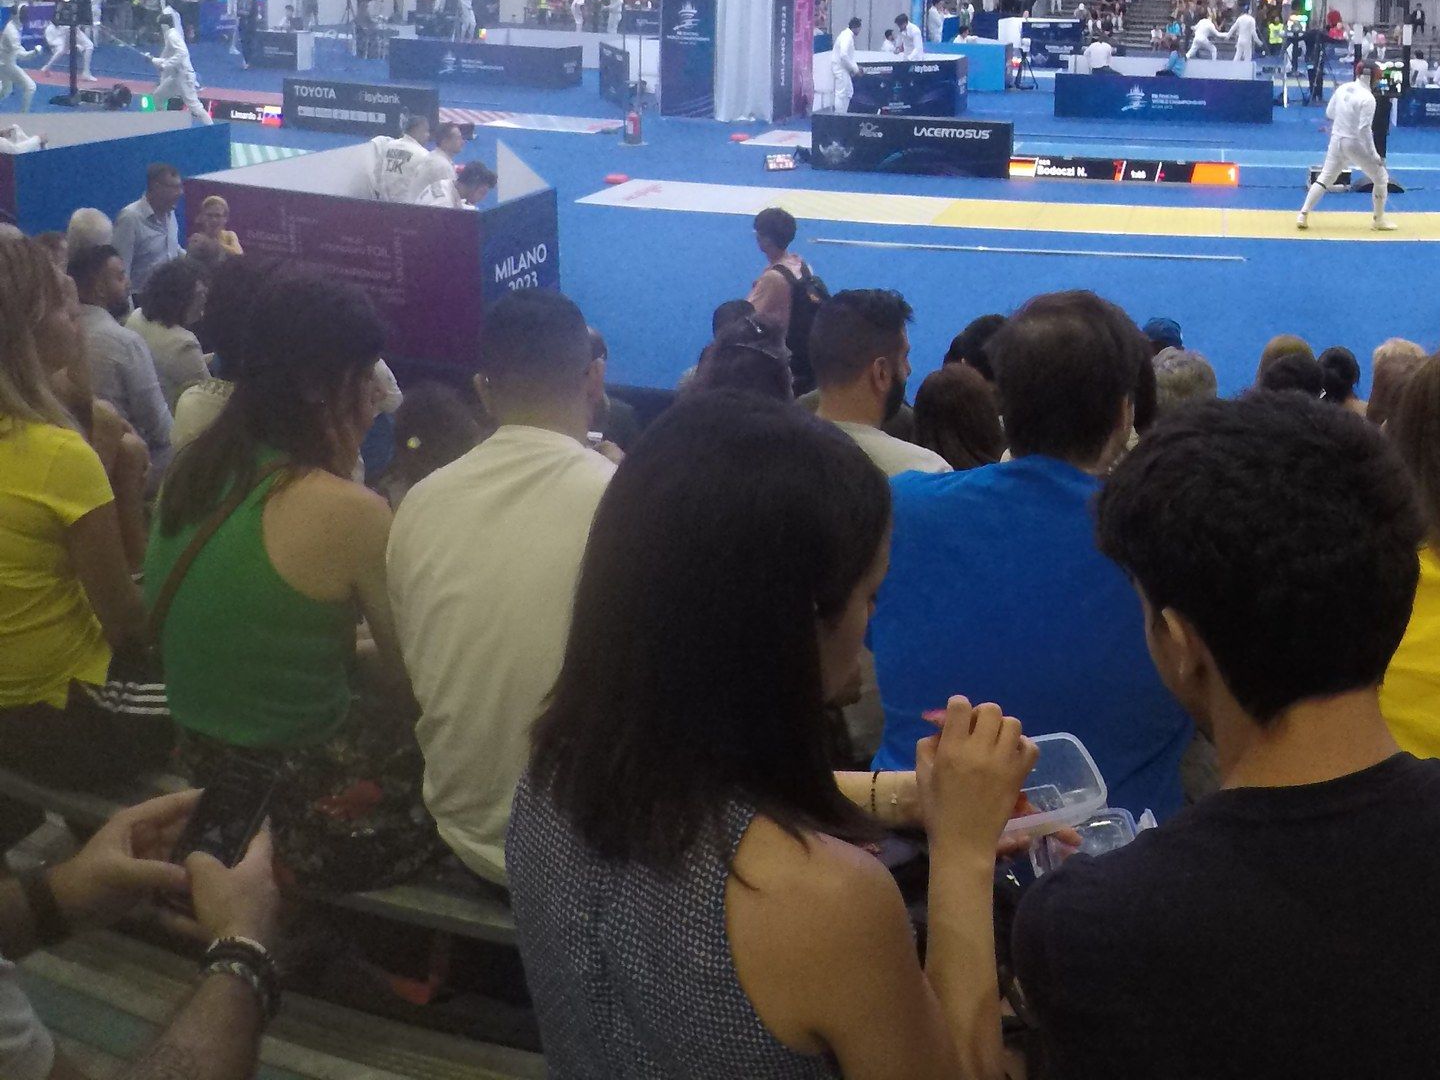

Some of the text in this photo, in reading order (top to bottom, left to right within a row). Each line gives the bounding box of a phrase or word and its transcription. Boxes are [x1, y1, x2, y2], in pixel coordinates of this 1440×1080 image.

[293, 85, 336, 99] TOYOTA
[914, 126, 992, 140] LACERTOSUS
[1037, 165, 1075, 177] Bodoczi
[494, 243, 548, 283] MILANO
